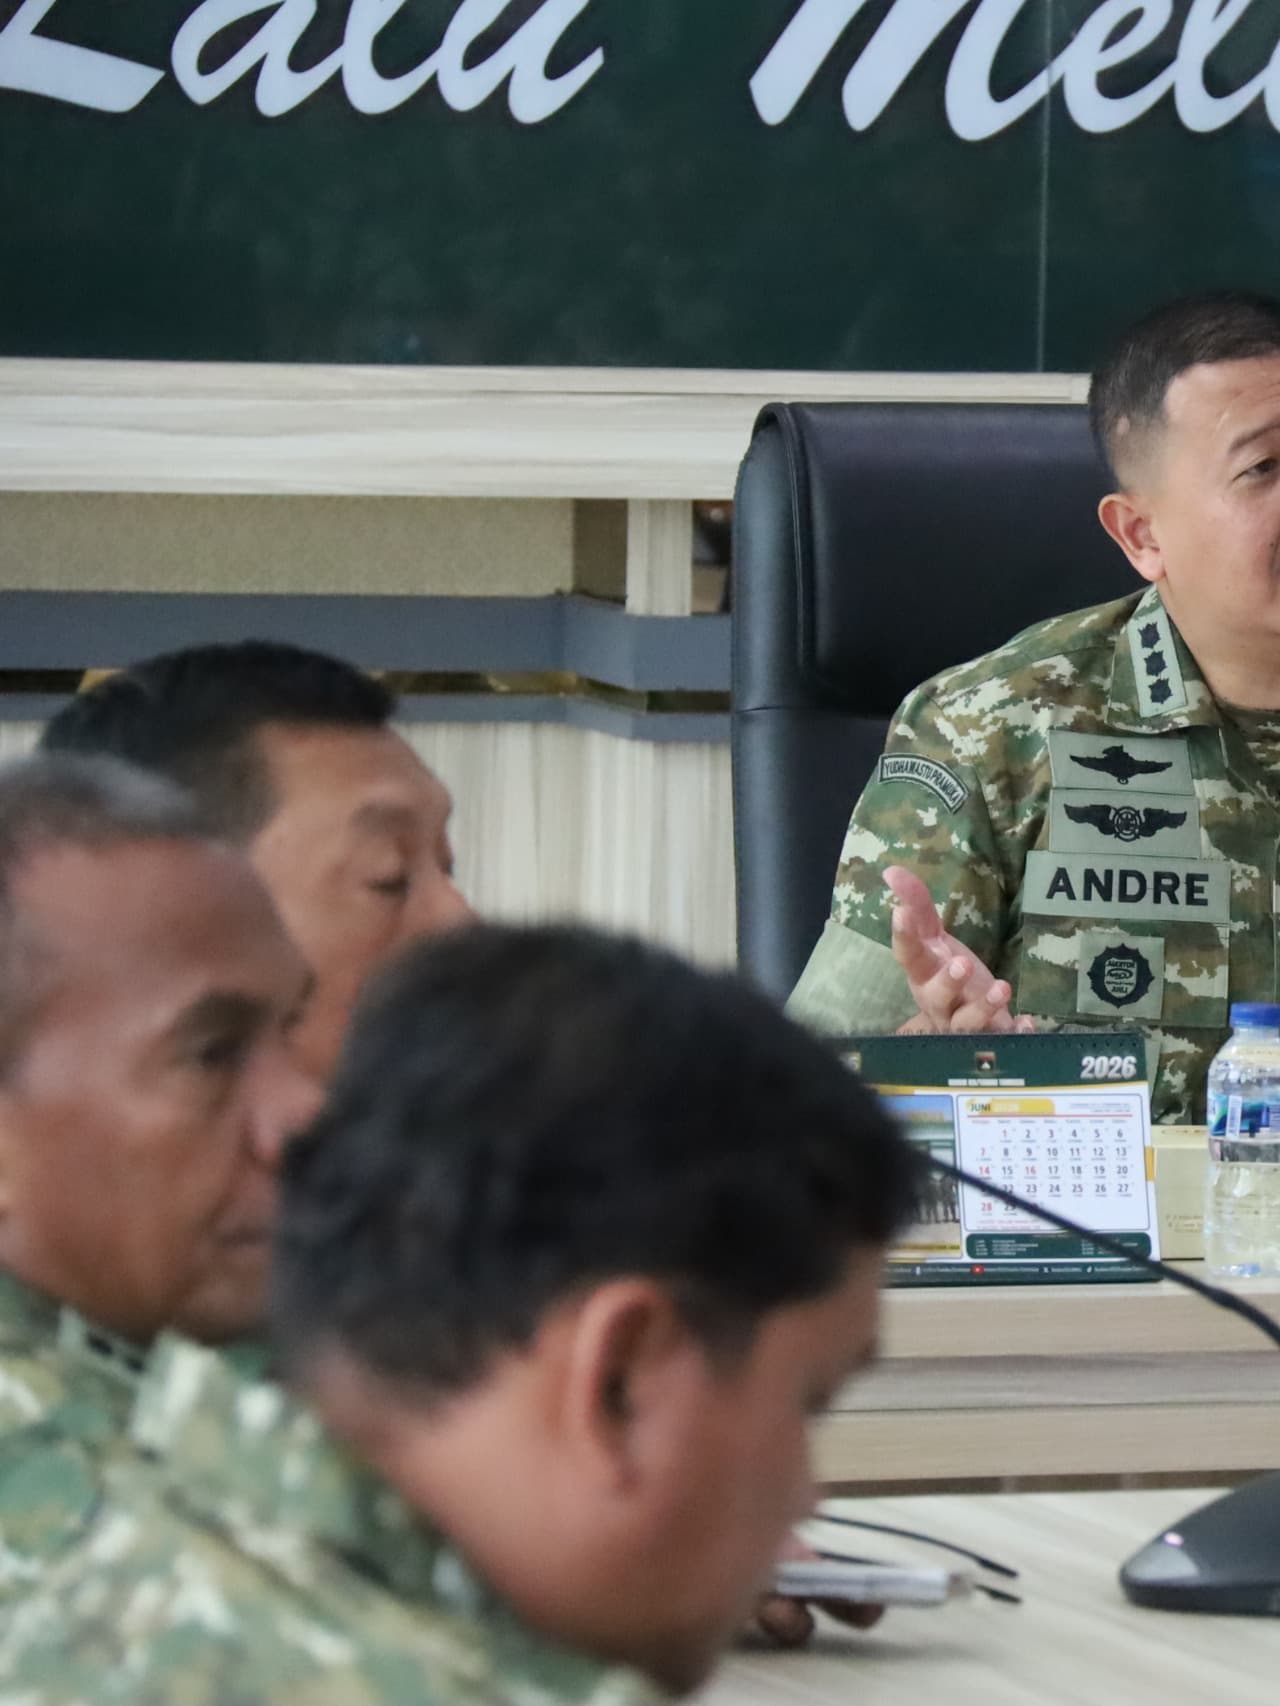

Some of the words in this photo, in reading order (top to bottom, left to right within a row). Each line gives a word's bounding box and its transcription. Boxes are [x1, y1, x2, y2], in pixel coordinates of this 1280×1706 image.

[1045, 867, 1210, 906] ANDRE
[1080, 1055, 1137, 1080] 2026
[970, 1103, 991, 1112] JUNI
[1046, 1147, 1059, 1157] 10
[1069, 1147, 1081, 1157] 11
[1093, 1147, 1104, 1157] 12
[1115, 1146, 1127, 1157] 13
[979, 1165, 990, 1176] 14
[1002, 1165, 1014, 1175] 15
[1025, 1165, 1037, 1175] 16
[1047, 1165, 1059, 1175] 17
[1071, 1165, 1082, 1175] 18
[1093, 1165, 1106, 1175] 19
[1116, 1165, 1129, 1175] 20
[1026, 1183, 1038, 1194] 23
[1049, 1183, 1061, 1193] 24
[1072, 1183, 1084, 1193] 25
[1095, 1183, 1107, 1193] 26
[1117, 1183, 1129, 1193] 27
[981, 1202, 993, 1212] 28
